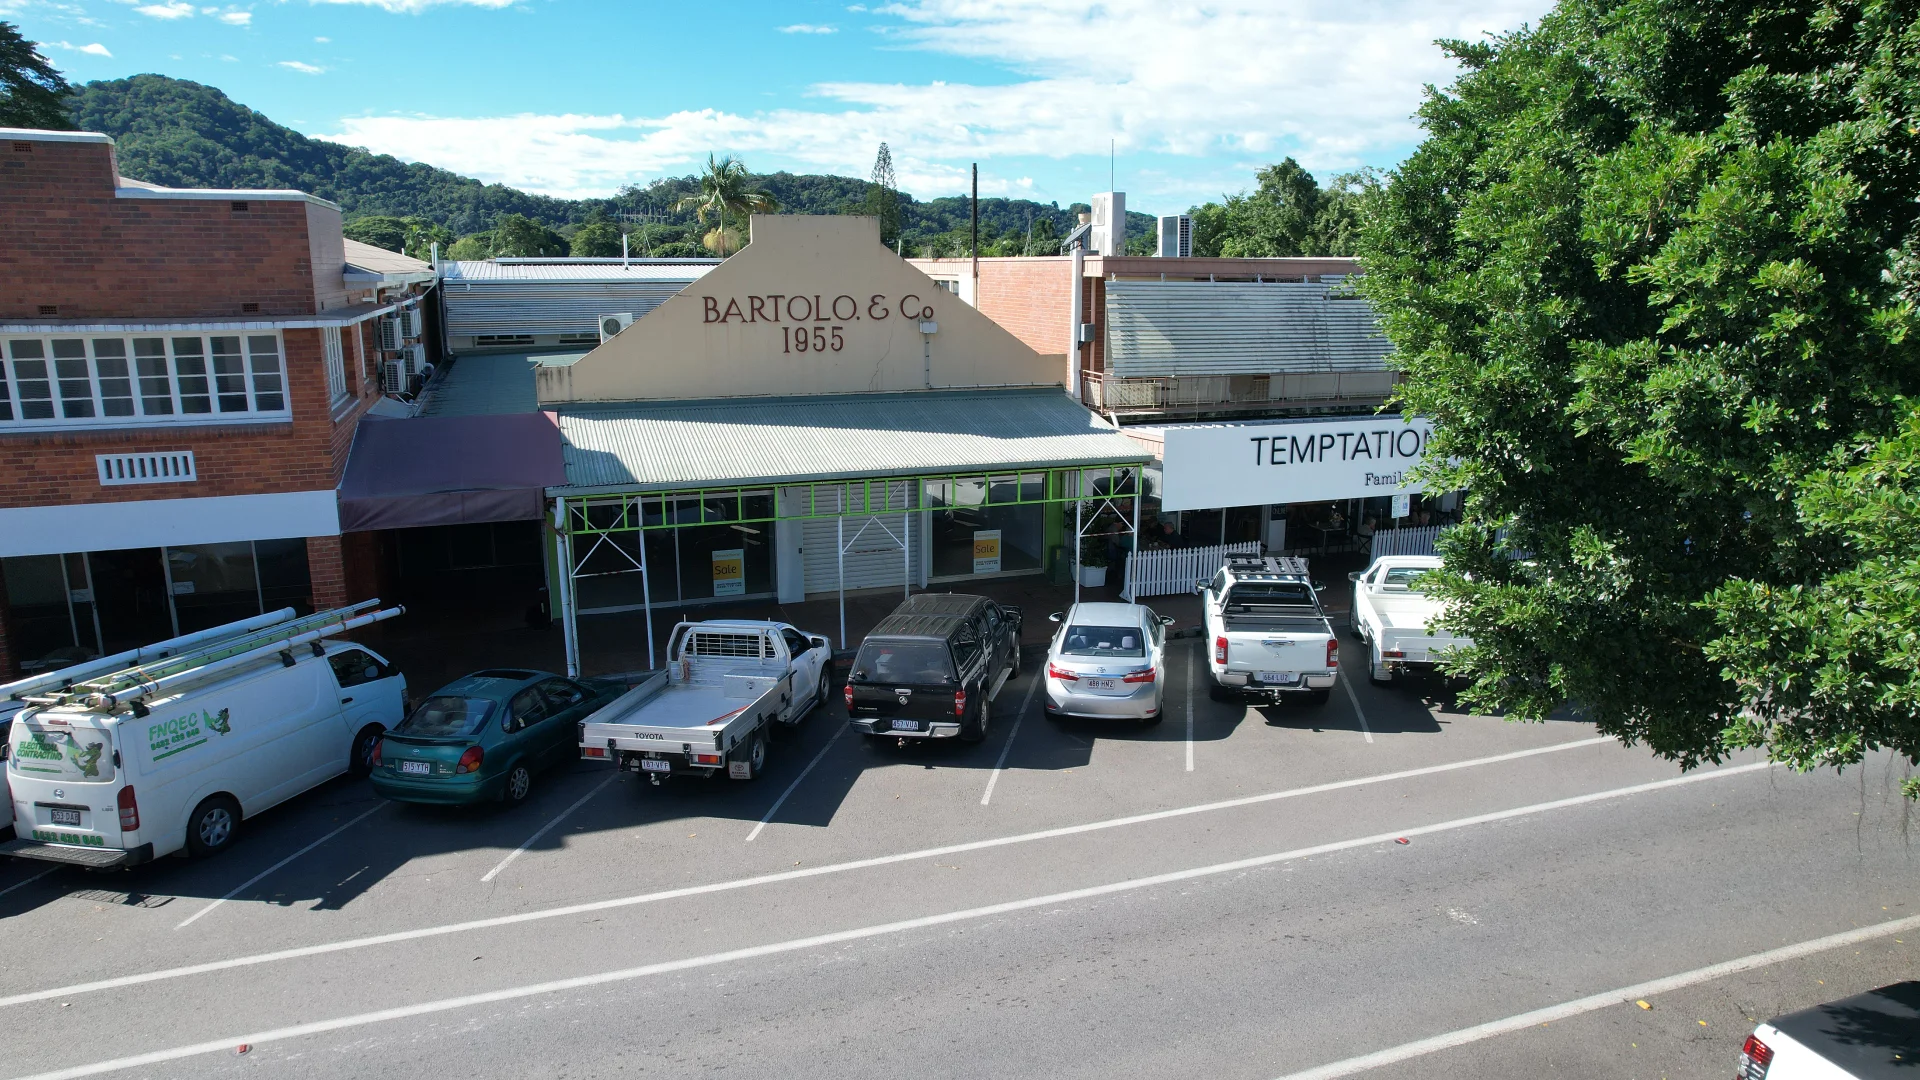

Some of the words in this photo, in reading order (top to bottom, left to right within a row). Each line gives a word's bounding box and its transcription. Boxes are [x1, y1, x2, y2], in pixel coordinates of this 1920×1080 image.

[868, 294, 890, 320] &
[900, 294, 934, 320] Co
[782, 326, 844, 353] 1955
[975, 544, 995, 554] Sale
[714, 564, 737, 575] Sale
[148, 712, 198, 741] FNQEC
[635, 732, 664, 740] TOYOTA
[20, 741, 58, 753] ELECTRICAL
[16, 749, 63, 760] CONTRACTING
